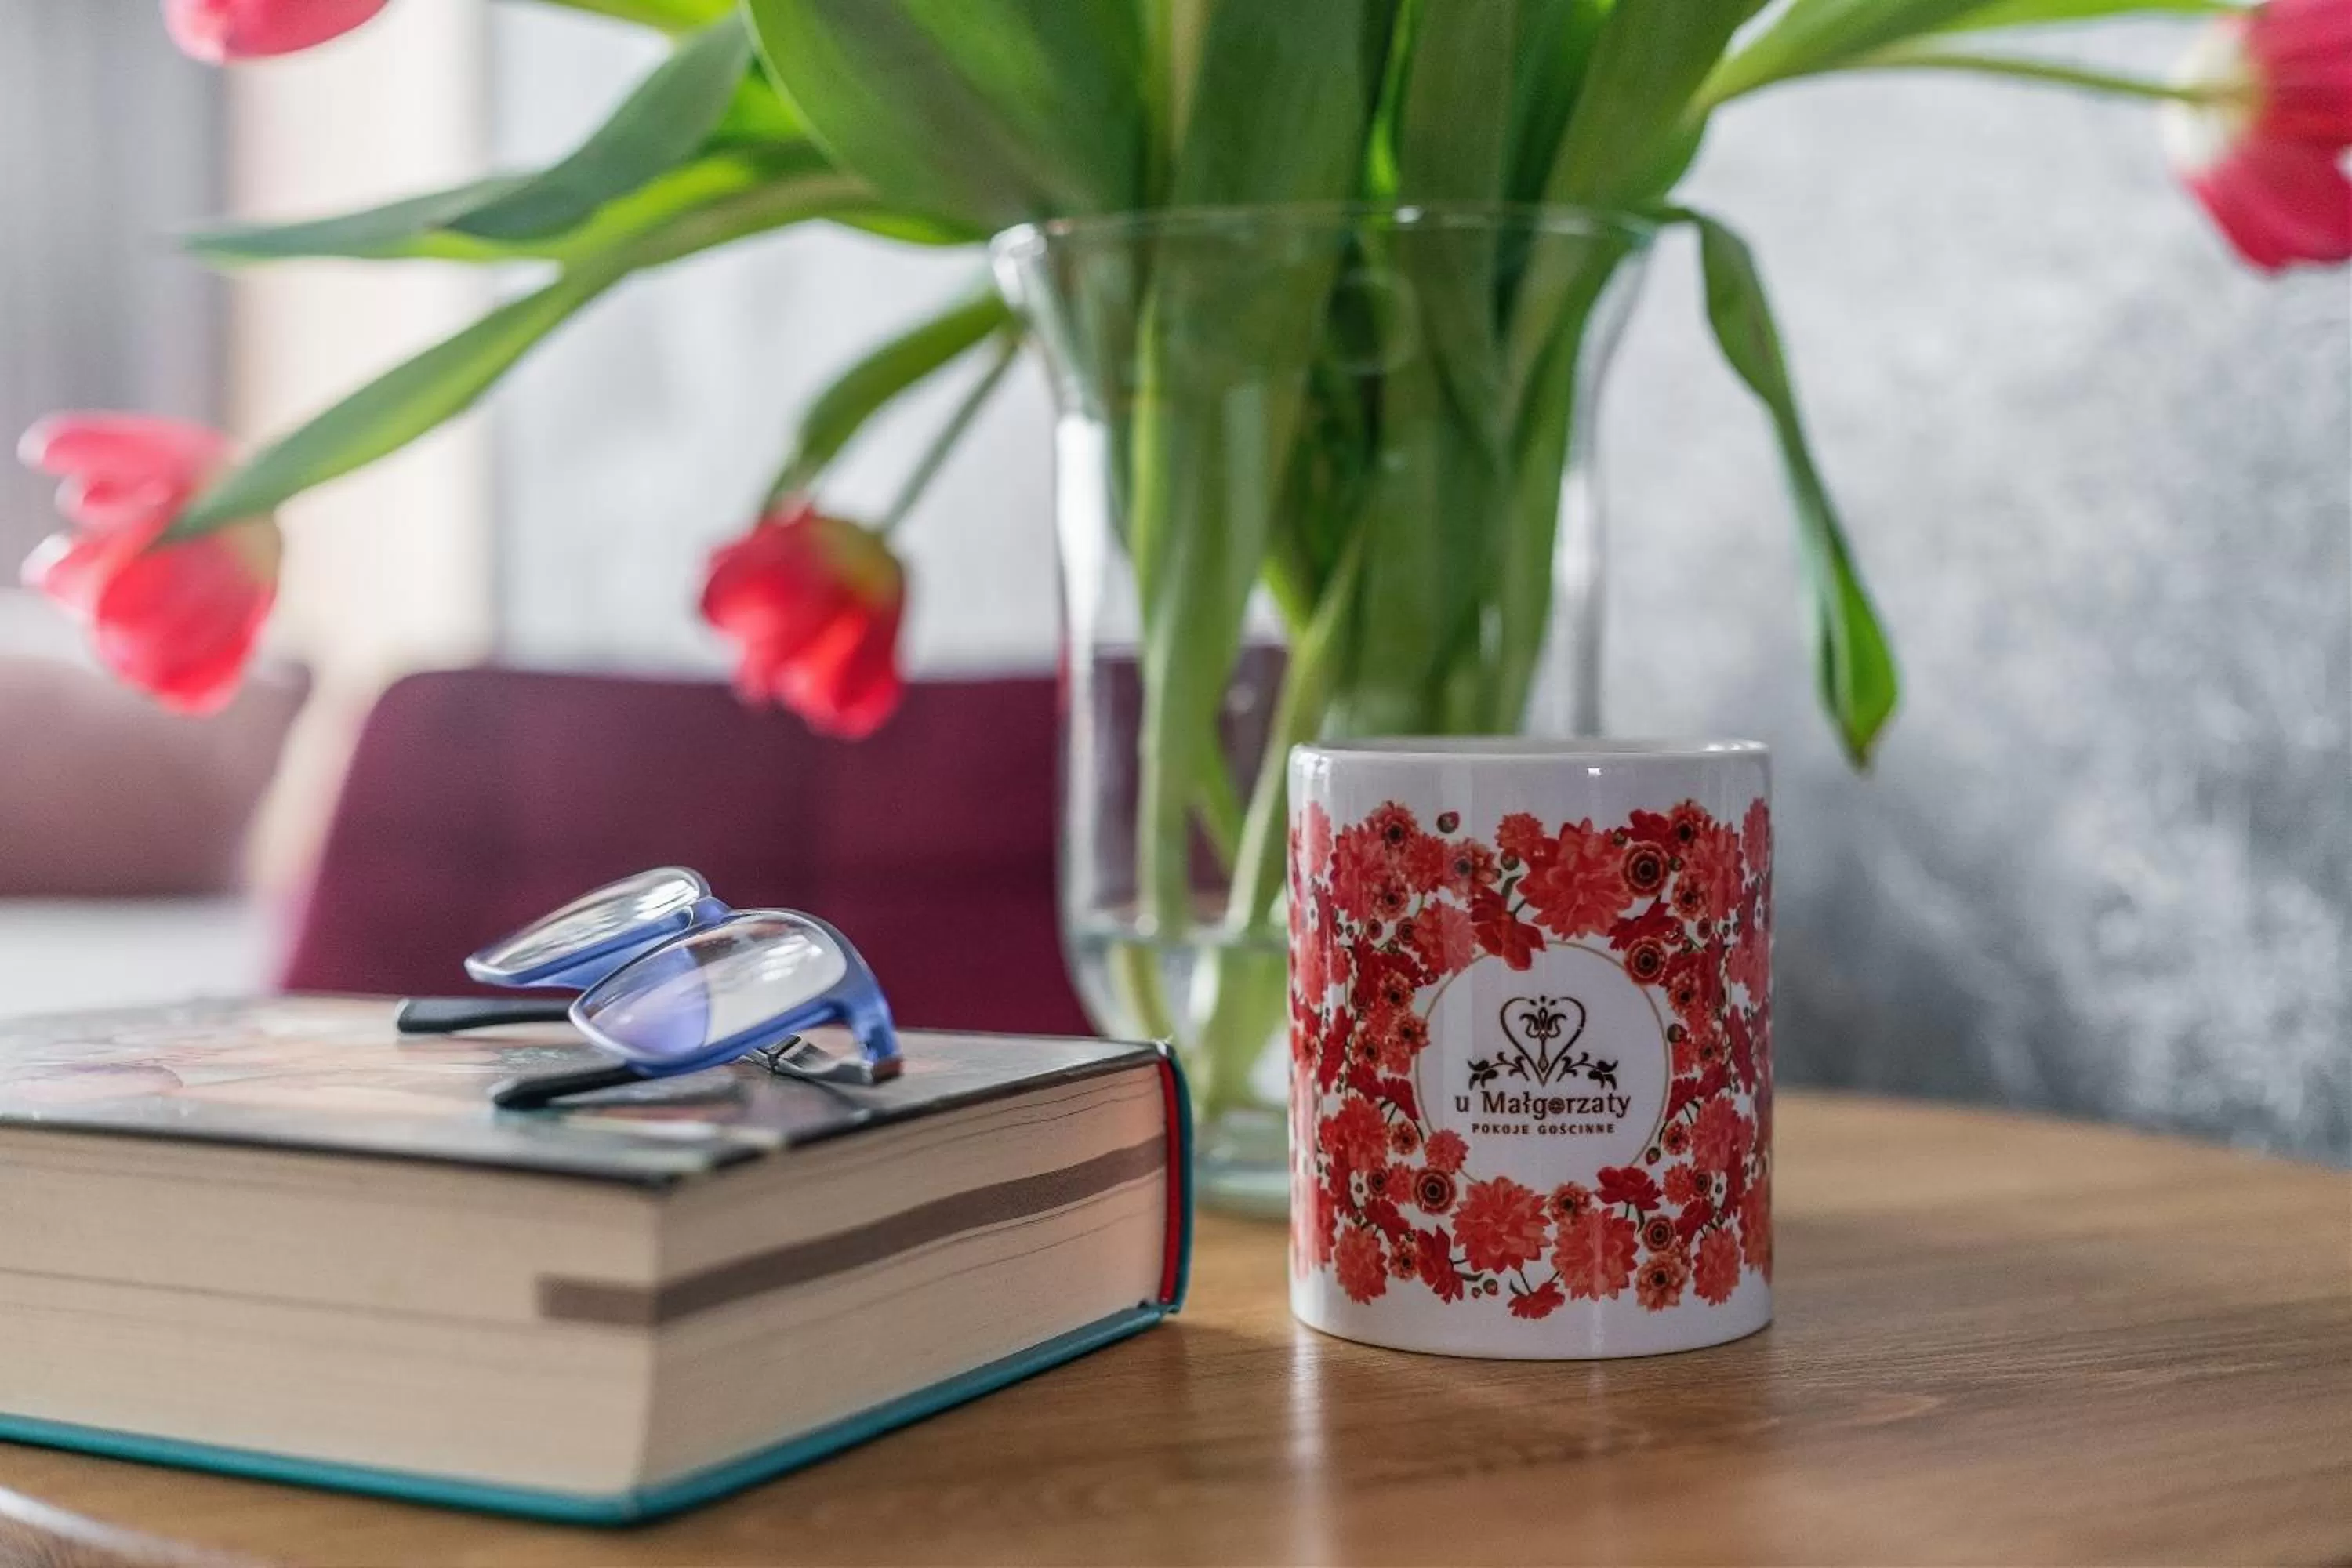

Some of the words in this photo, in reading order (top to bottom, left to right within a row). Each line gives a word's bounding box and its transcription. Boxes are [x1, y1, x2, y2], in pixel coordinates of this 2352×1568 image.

[1455, 1095, 1470, 1112] u
[1480, 1091, 1632, 1120] Małgorzaty
[1472, 1123, 1529, 1134] POKOJE
[1537, 1121, 1616, 1135] GOŚCINNE
